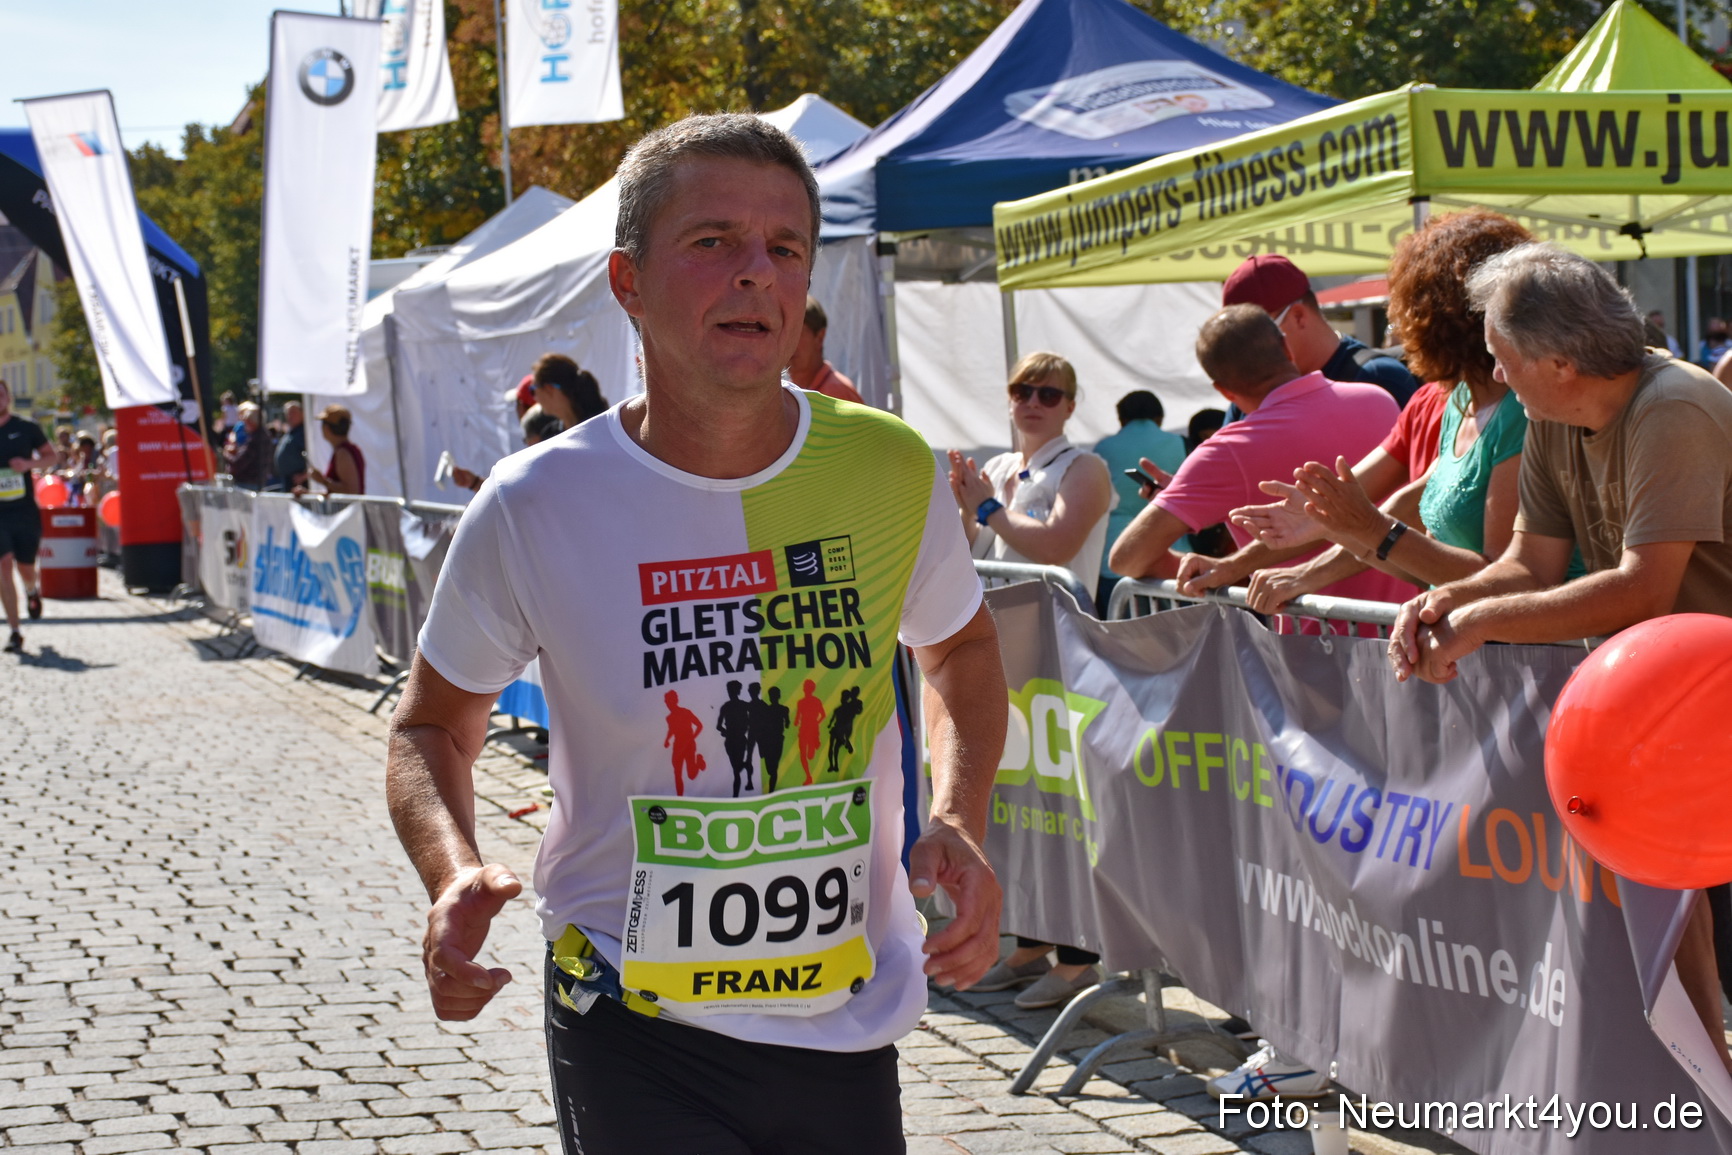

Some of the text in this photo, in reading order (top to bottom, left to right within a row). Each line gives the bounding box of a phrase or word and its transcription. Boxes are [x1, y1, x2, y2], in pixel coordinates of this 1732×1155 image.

[998, 113, 1400, 267] www.jumpers-fitness.com
[651, 561, 767, 595] PITZTAL
[828, 546, 845, 554] COMP
[641, 587, 865, 646] GLETSCHER
[643, 631, 872, 689] MARATHON
[1134, 727, 1273, 808] OFFICE
[658, 799, 852, 855] BOCK
[993, 793, 1017, 833] by
[853, 864, 862, 877] C
[661, 866, 849, 948] 1099
[692, 963, 822, 995] FRANZ
